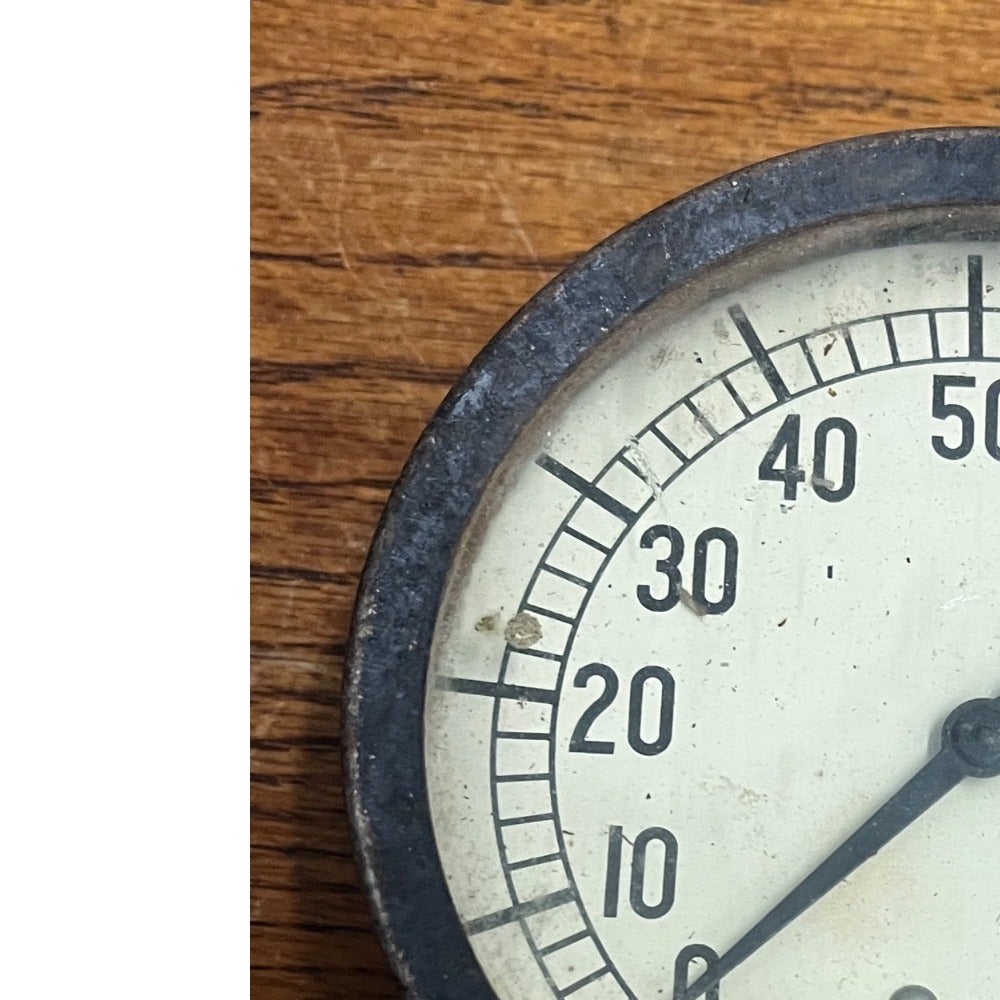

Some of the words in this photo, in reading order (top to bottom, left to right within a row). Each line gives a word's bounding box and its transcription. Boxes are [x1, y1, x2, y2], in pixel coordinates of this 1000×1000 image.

[758, 414, 857, 503] 40
[636, 524, 739, 616] 30
[568, 662, 675, 757] 20
[603, 825, 679, 920] 10
